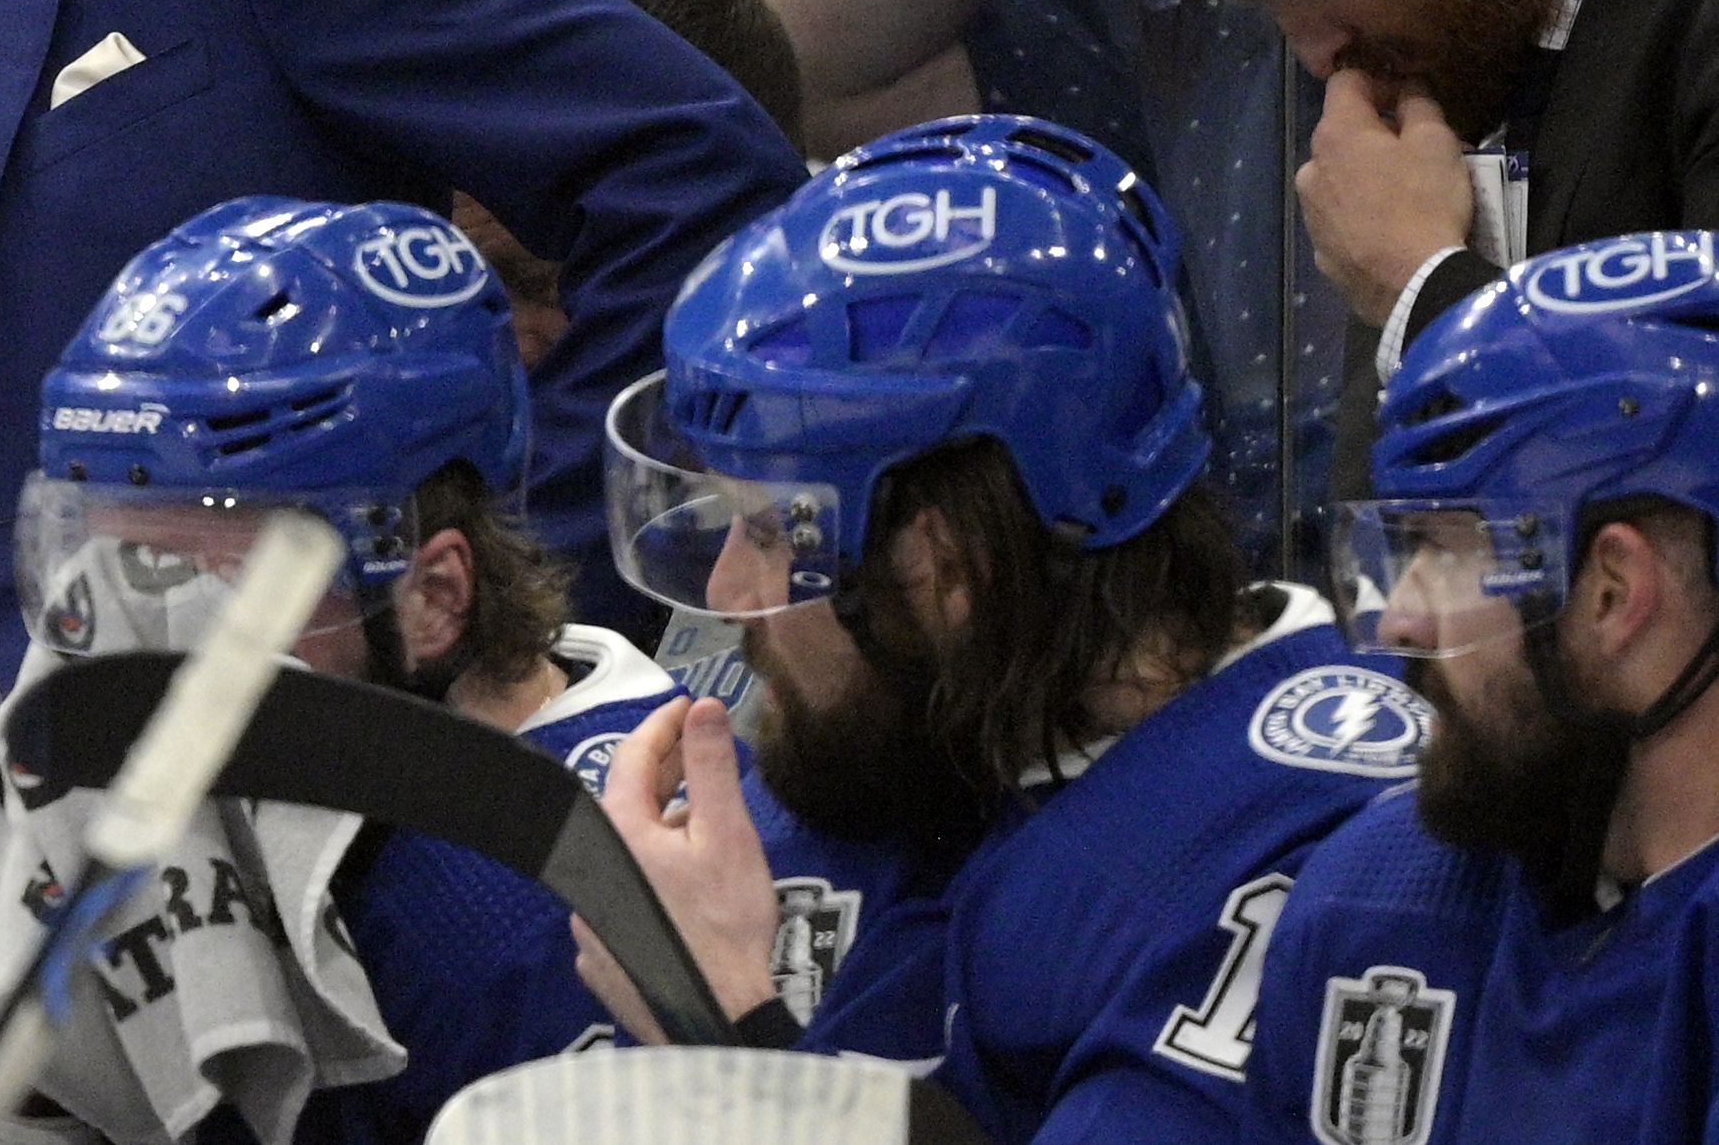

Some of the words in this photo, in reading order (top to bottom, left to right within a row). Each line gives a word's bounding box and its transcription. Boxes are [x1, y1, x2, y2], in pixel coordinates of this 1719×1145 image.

[837, 187, 996, 255] TGH
[362, 224, 486, 288] TGH
[1541, 231, 1714, 298] TGH
[1277, 677, 1325, 710] BAY
[1152, 871, 1296, 1083] 1
[1403, 1028, 1430, 1050] 22
